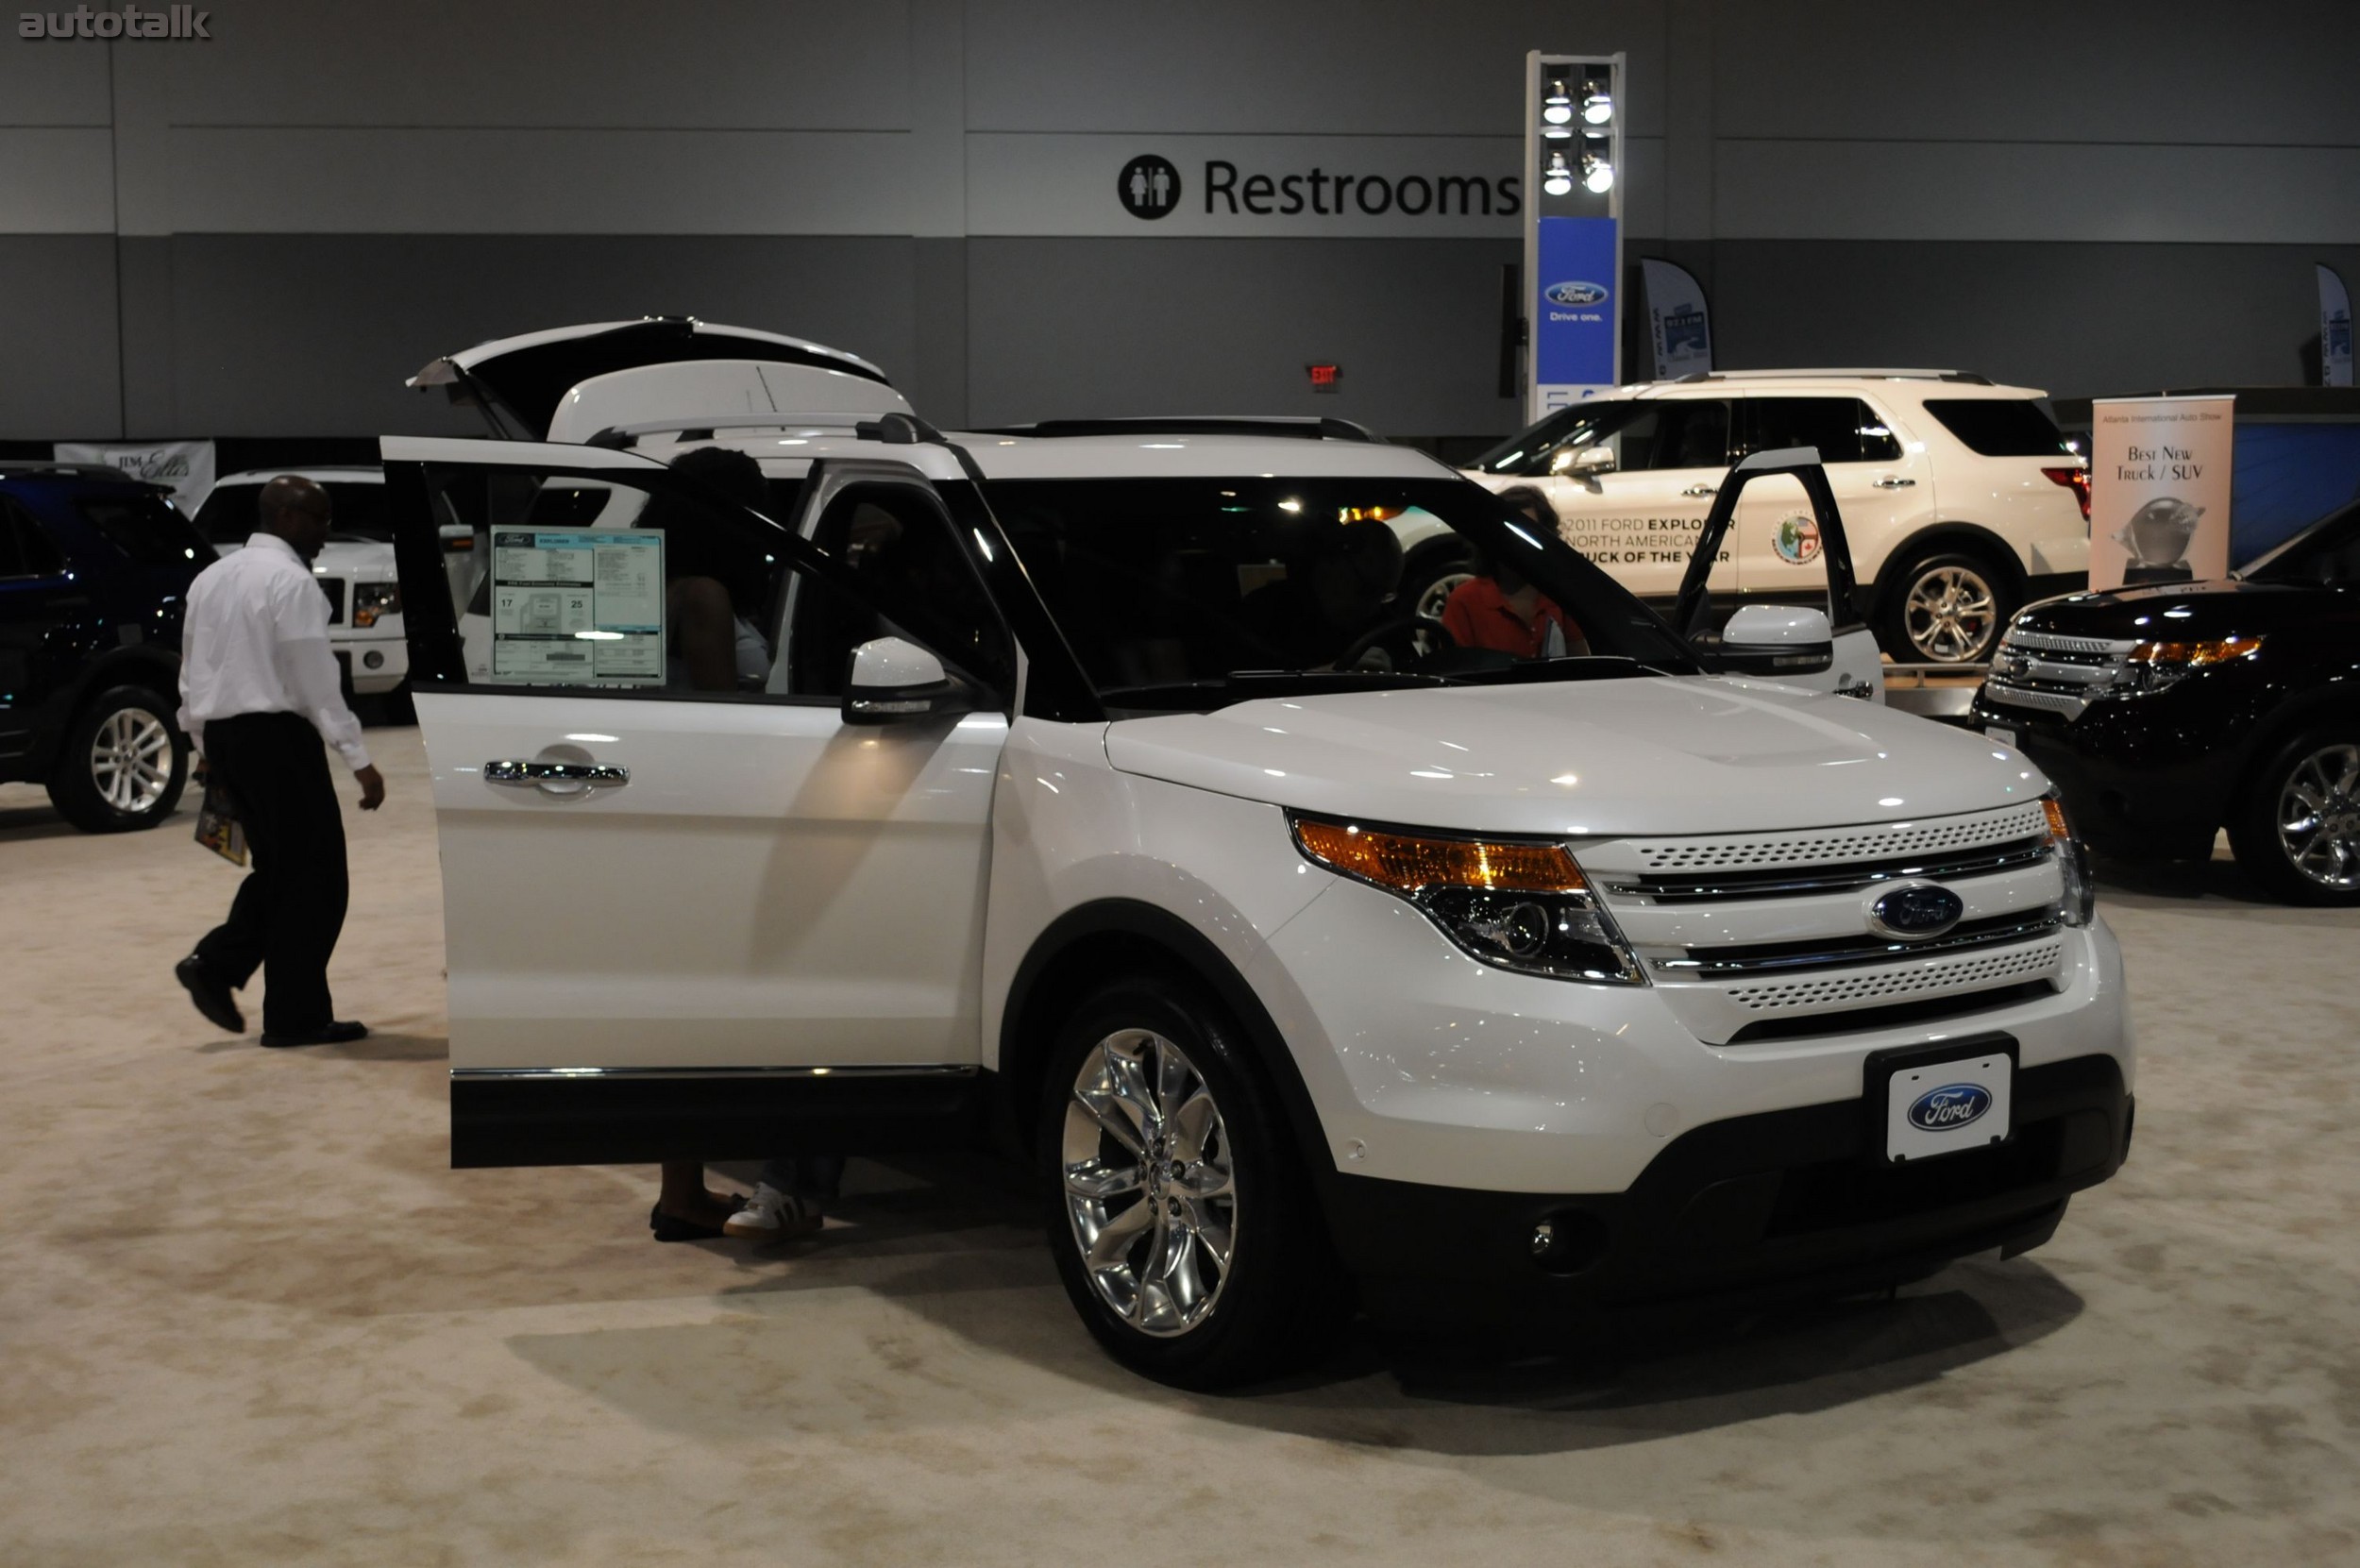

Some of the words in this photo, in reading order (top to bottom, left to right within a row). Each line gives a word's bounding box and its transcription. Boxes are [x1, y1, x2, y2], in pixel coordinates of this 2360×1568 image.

[1205, 160, 1520, 215] Restrooms
[1557, 286, 1595, 303] Ford
[1549, 312, 1578, 322] Drive
[1580, 313, 1603, 322] one.
[2103, 415, 2129, 424] Atlanta
[2131, 413, 2178, 423] International
[2200, 412, 2222, 421] Show
[2172, 464, 2203, 481] SUV
[1566, 518, 1597, 531] 2011
[1601, 518, 1644, 531] FORD
[1648, 519, 1735, 531] EXPLOR
[504, 534, 525, 544] Ford
[1565, 534, 1621, 547] NORTH
[1624, 551, 1646, 563] OF
[1650, 551, 1681, 563] THE
[501, 599, 513, 607] 17
[570, 599, 582, 609] 25
[1898, 893, 1948, 925] Ford
[1925, 1092, 1975, 1125] Ford
